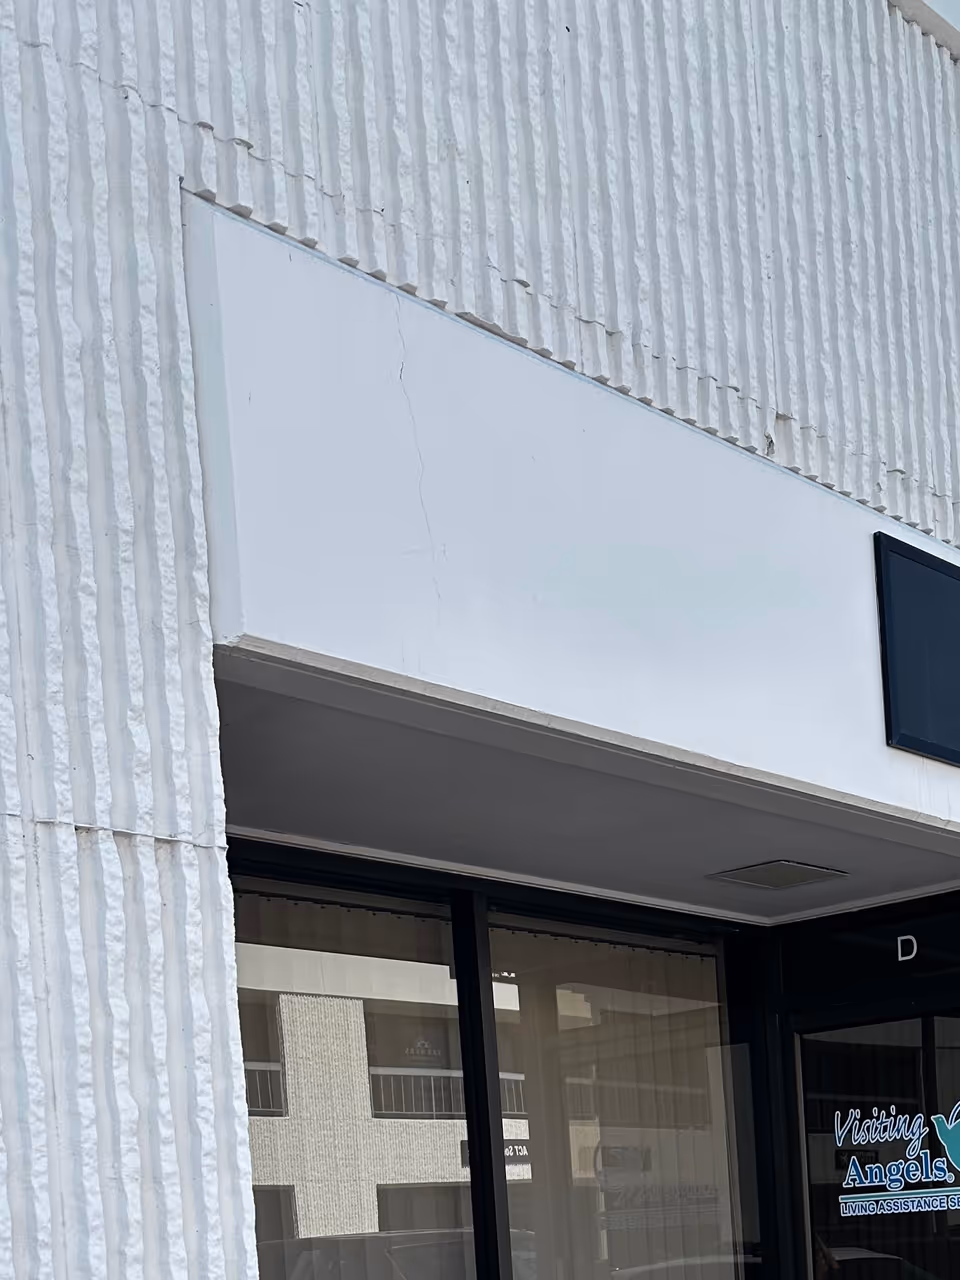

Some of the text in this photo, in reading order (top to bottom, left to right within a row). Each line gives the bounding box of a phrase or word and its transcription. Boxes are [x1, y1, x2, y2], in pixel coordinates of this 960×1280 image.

[897, 934, 918, 962] D
[833, 1105, 929, 1158] Visiting
[840, 1202, 879, 1216] LIVING
[877, 1196, 948, 1214] ASSISTANCE
